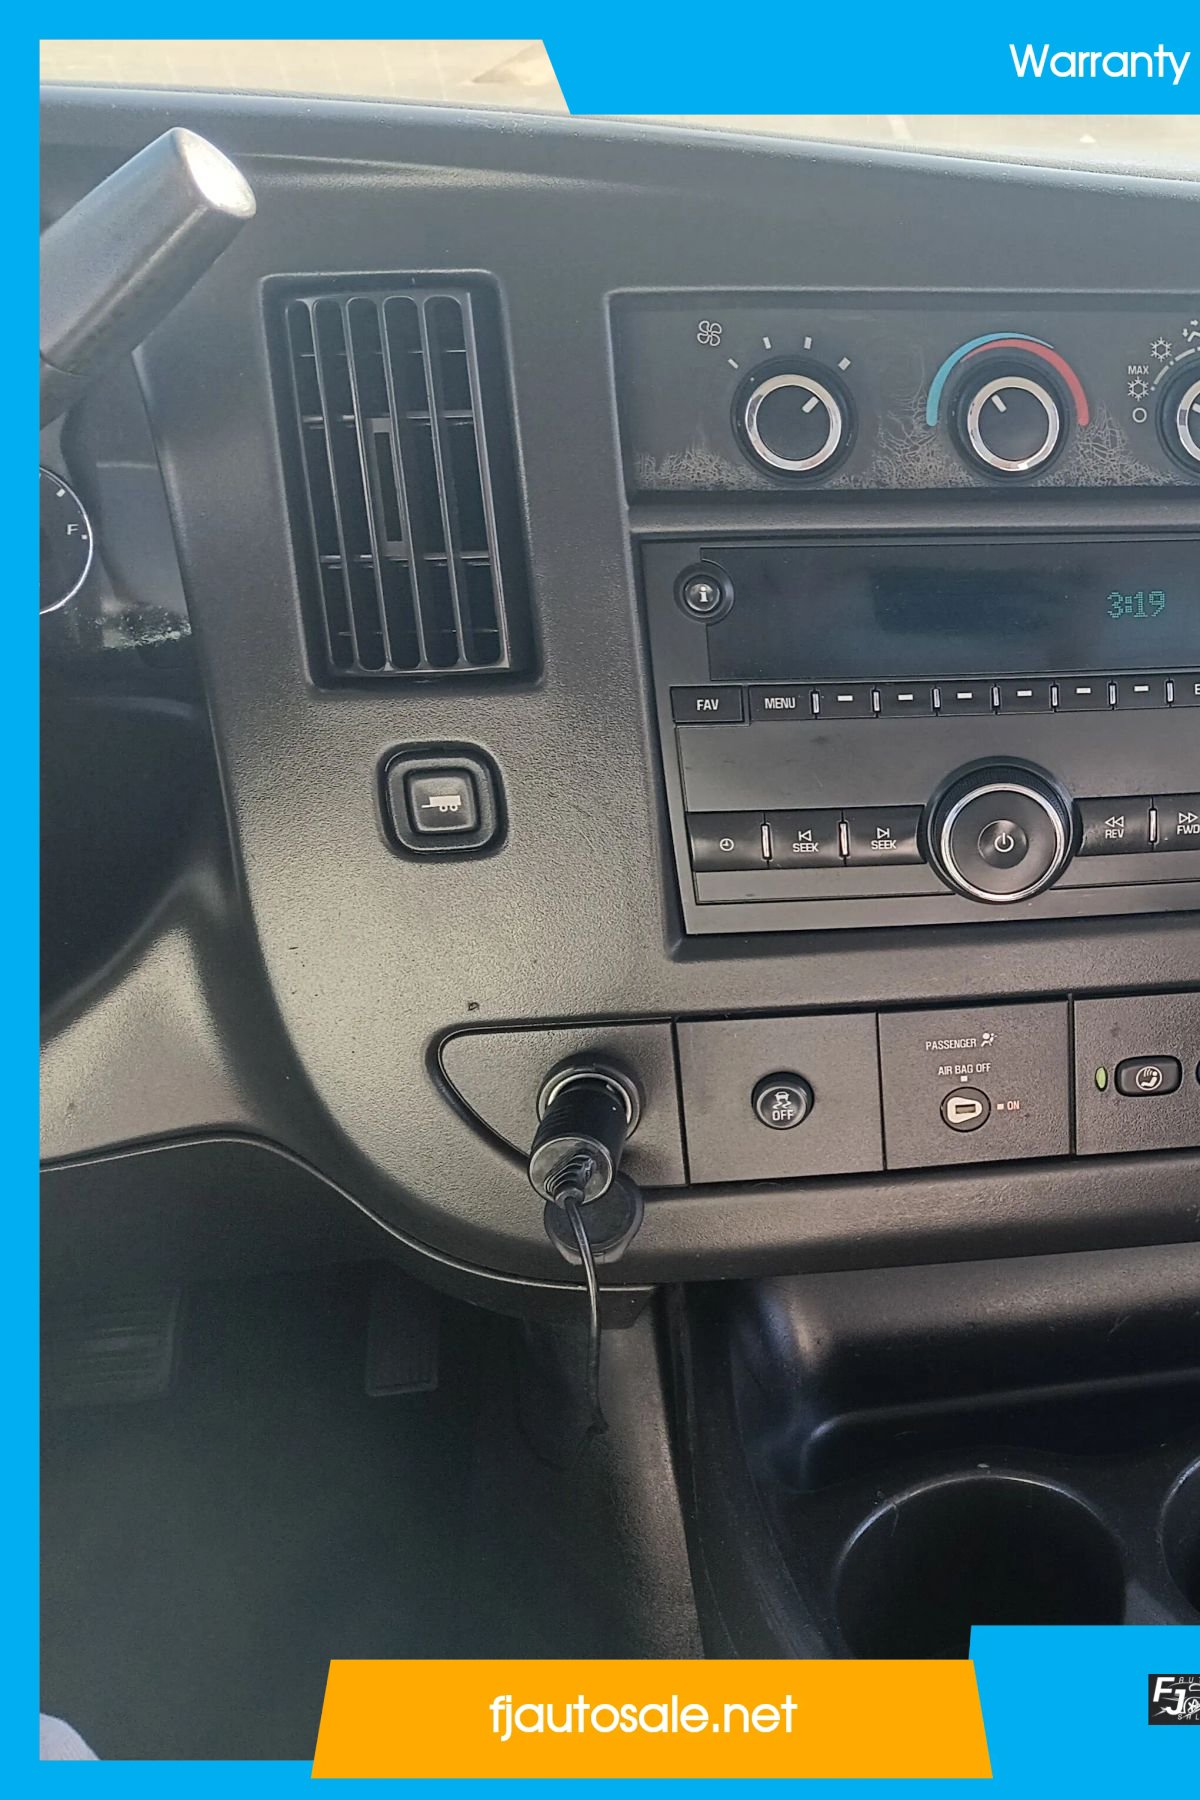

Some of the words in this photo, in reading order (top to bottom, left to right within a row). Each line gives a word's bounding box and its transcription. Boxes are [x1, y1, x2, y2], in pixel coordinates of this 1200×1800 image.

[1128, 365, 1149, 375] MAX
[67, 523, 79, 536] F
[1107, 590, 1166, 619] 3:19
[696, 699, 719, 711] FAV
[764, 697, 796, 710] MENU
[1105, 829, 1124, 839] REV
[1176, 824, 1200, 835] FWD
[792, 842, 819, 853] SEEK
[870, 839, 897, 850] SEEK
[925, 1037, 977, 1051] PASSENGER
[938, 1064, 953, 1076] AIR
[955, 1064, 973, 1075] BAG
[976, 1062, 992, 1073] OFF
[1007, 1100, 1020, 1111] ON
[772, 1109, 795, 1121] OFF
